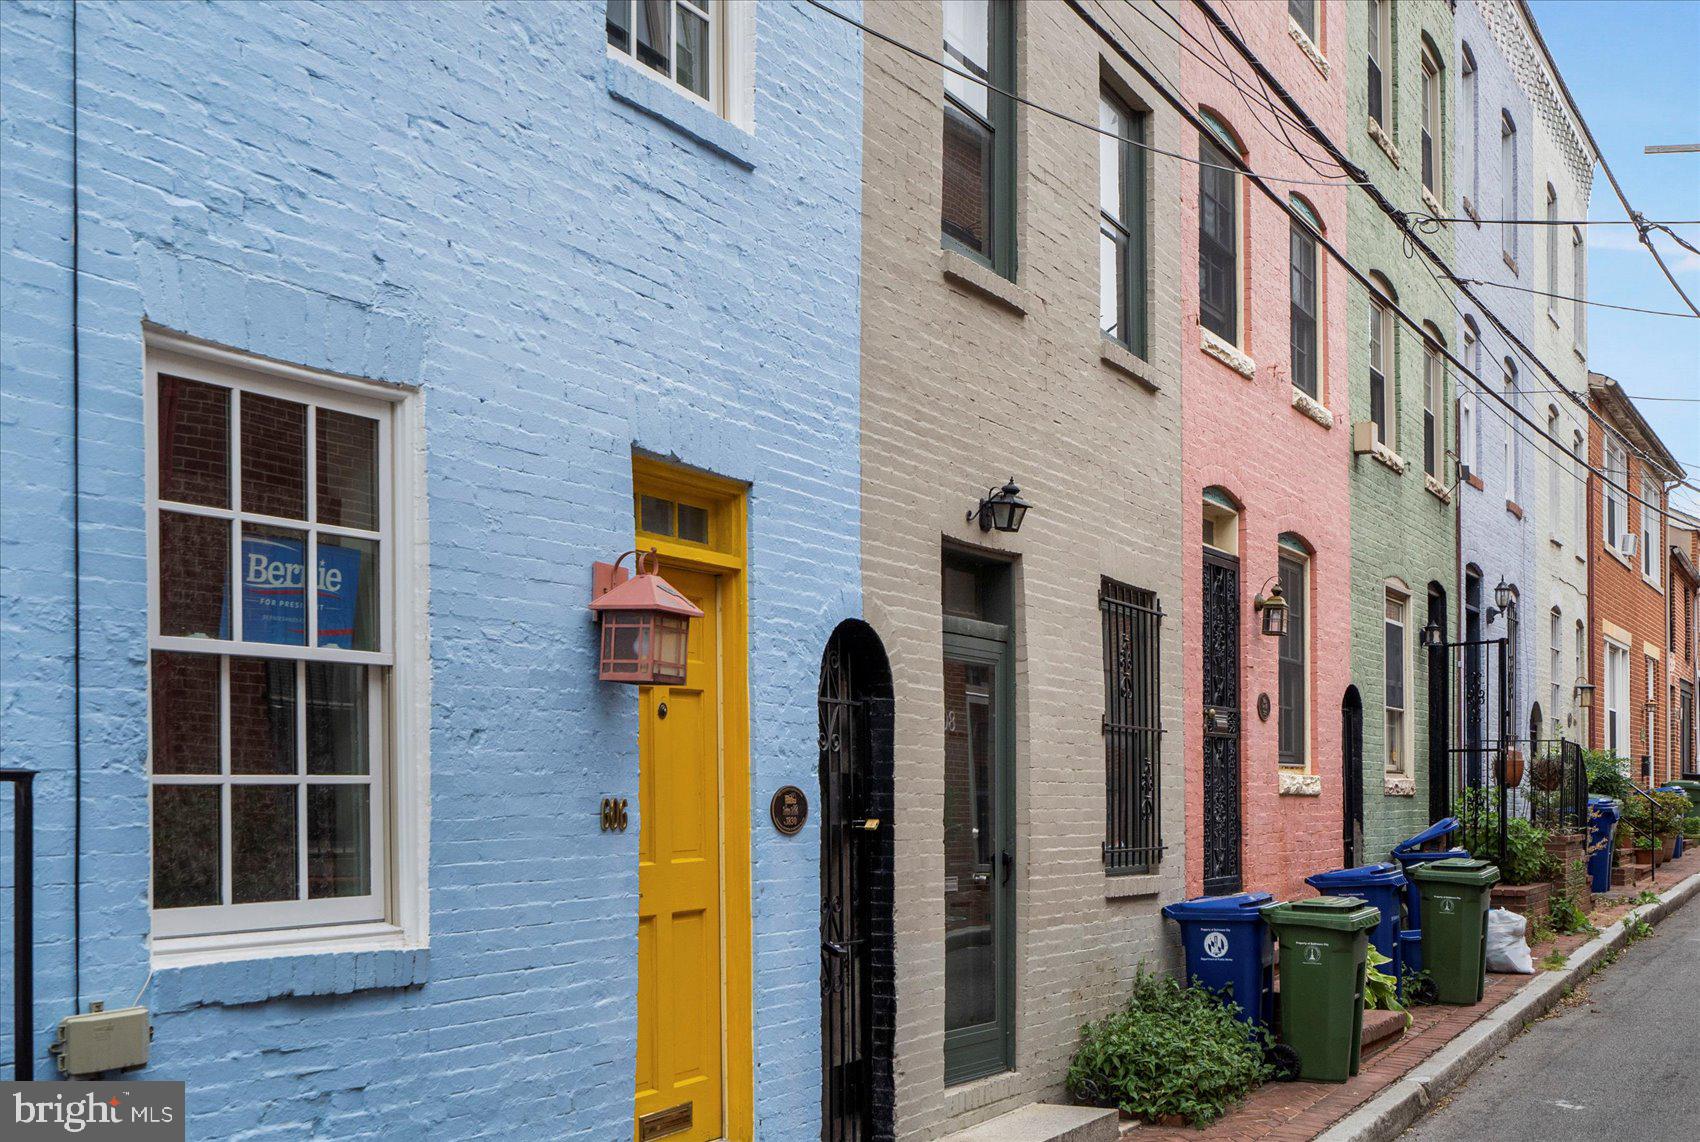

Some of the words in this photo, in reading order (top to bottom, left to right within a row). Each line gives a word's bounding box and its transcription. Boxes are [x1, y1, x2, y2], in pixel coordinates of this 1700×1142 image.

[246, 553, 342, 592] Berie
[260, 598, 276, 606] FOR
[279, 600, 324, 611] PRESIT
